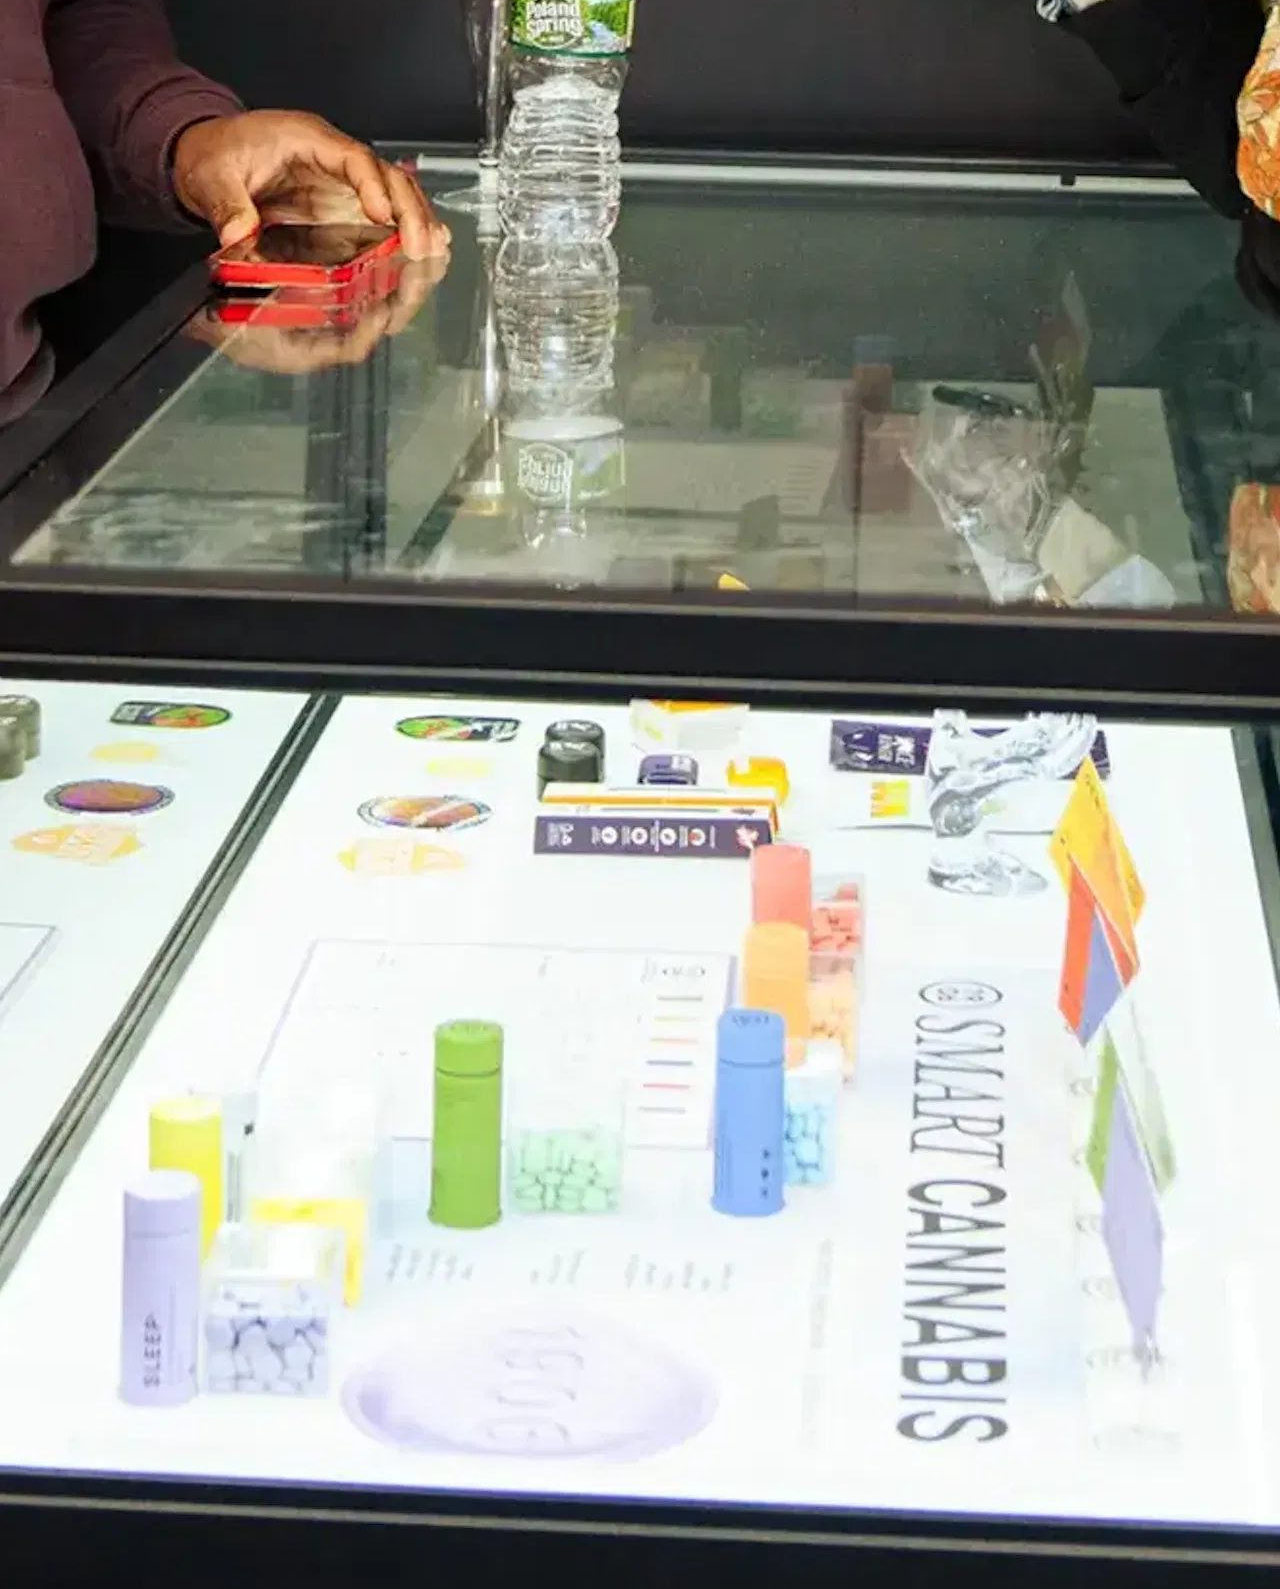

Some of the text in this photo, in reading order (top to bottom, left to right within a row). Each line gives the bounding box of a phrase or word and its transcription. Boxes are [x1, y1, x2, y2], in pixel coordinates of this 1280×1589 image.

[910, 1015, 1006, 1169] SMART
[143, 1312, 162, 1388] SLEEP
[897, 1179, 1008, 1442] CANNABIS
